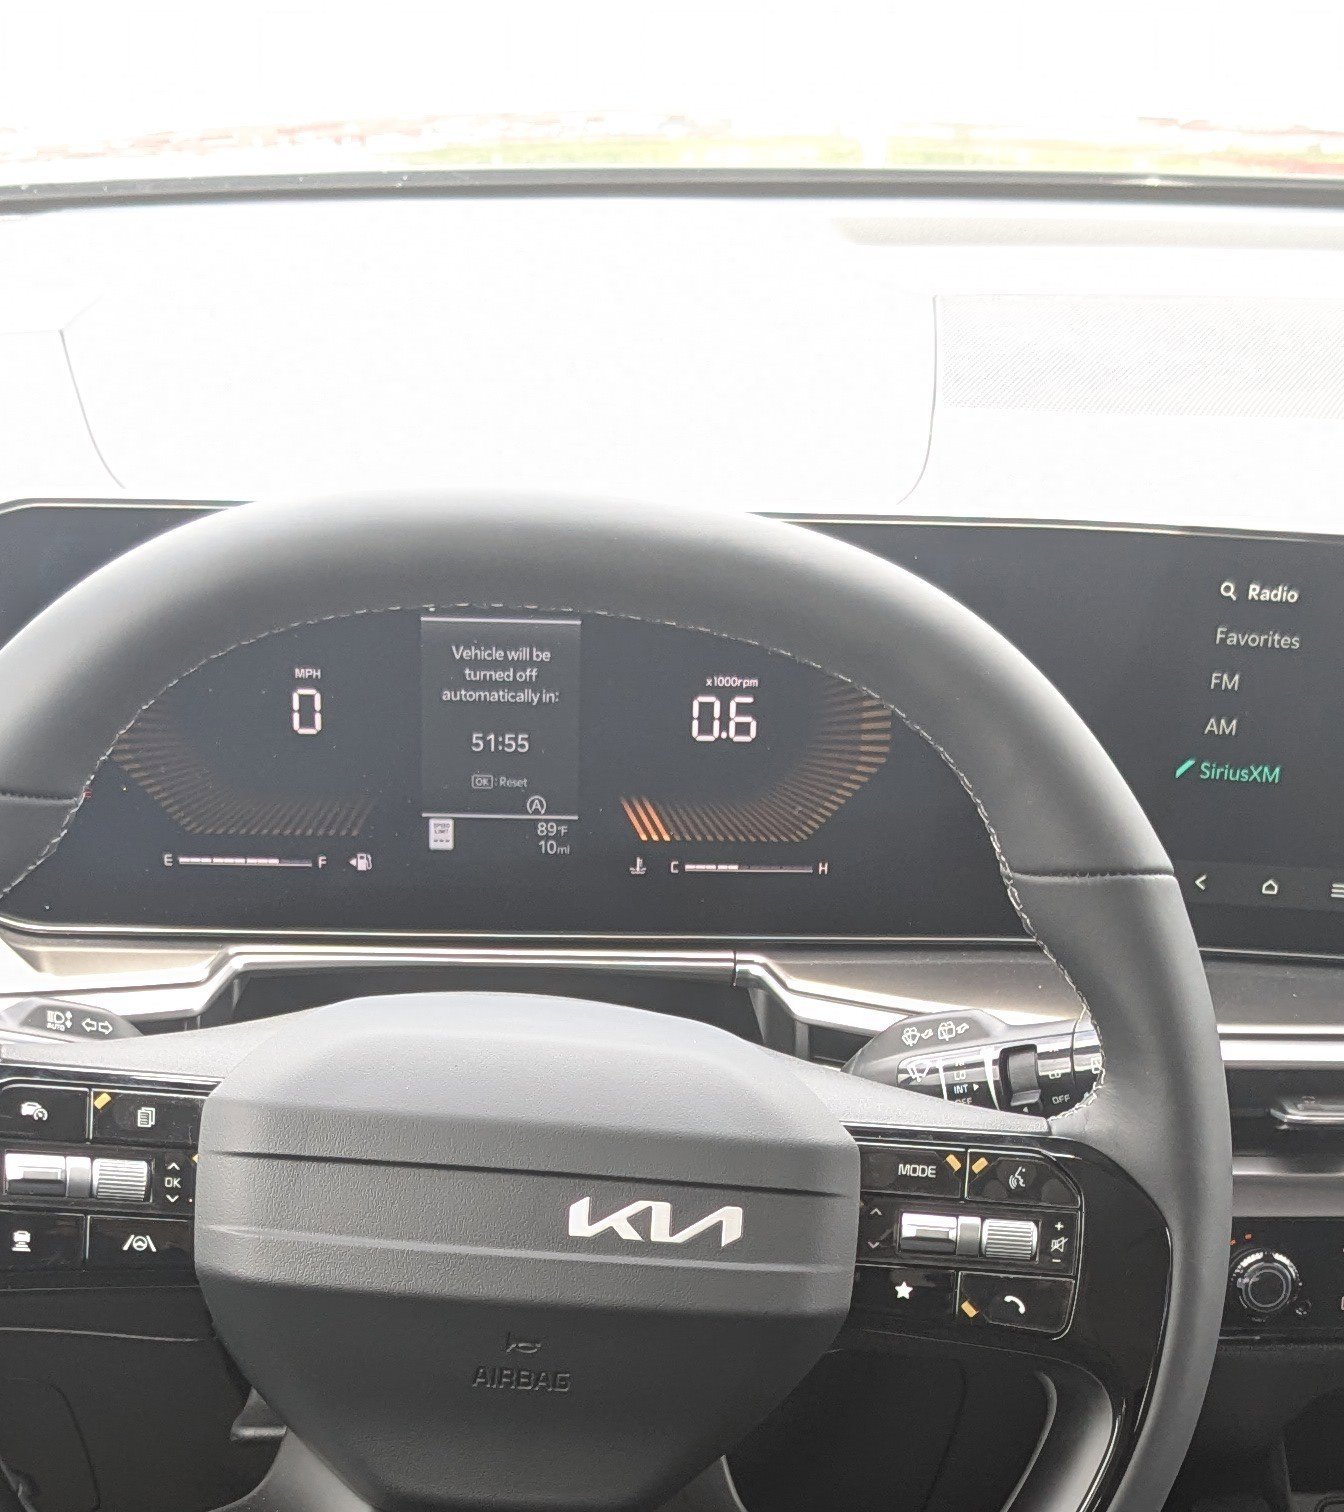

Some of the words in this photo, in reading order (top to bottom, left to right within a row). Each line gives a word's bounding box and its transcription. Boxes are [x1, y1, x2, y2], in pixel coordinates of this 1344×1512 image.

[1248, 583, 1299, 603] Radio
[1215, 627, 1301, 650] Favorites
[451, 645, 504, 661] Vehicle
[506, 647, 530, 661] will
[532, 647, 552, 662] be
[294, 667, 322, 679] MPH
[464, 667, 514, 682] turned
[516, 668, 538, 682] off
[705, 676, 759, 689] x1000rpm
[1210, 672, 1241, 692] FM
[442, 688, 539, 705] automatically
[292, 688, 322, 735] 0
[691, 695, 757, 743] 0.6
[1204, 717, 1238, 737] AM
[471, 732, 530, 752] 51:55
[1199, 762, 1282, 784] SiriusXM
[499, 776, 528, 788] Reset
[163, 853, 174, 868] E
[317, 855, 328, 869] F
[669, 860, 680, 875] C
[818, 861, 829, 876] H
[954, 1084, 969, 1095] INT
[1052, 1094, 1071, 1104] OFF
[898, 1163, 937, 1178] MODE
[164, 1177, 182, 1189] OK
[471, 1365, 572, 1393] AIRBAG
